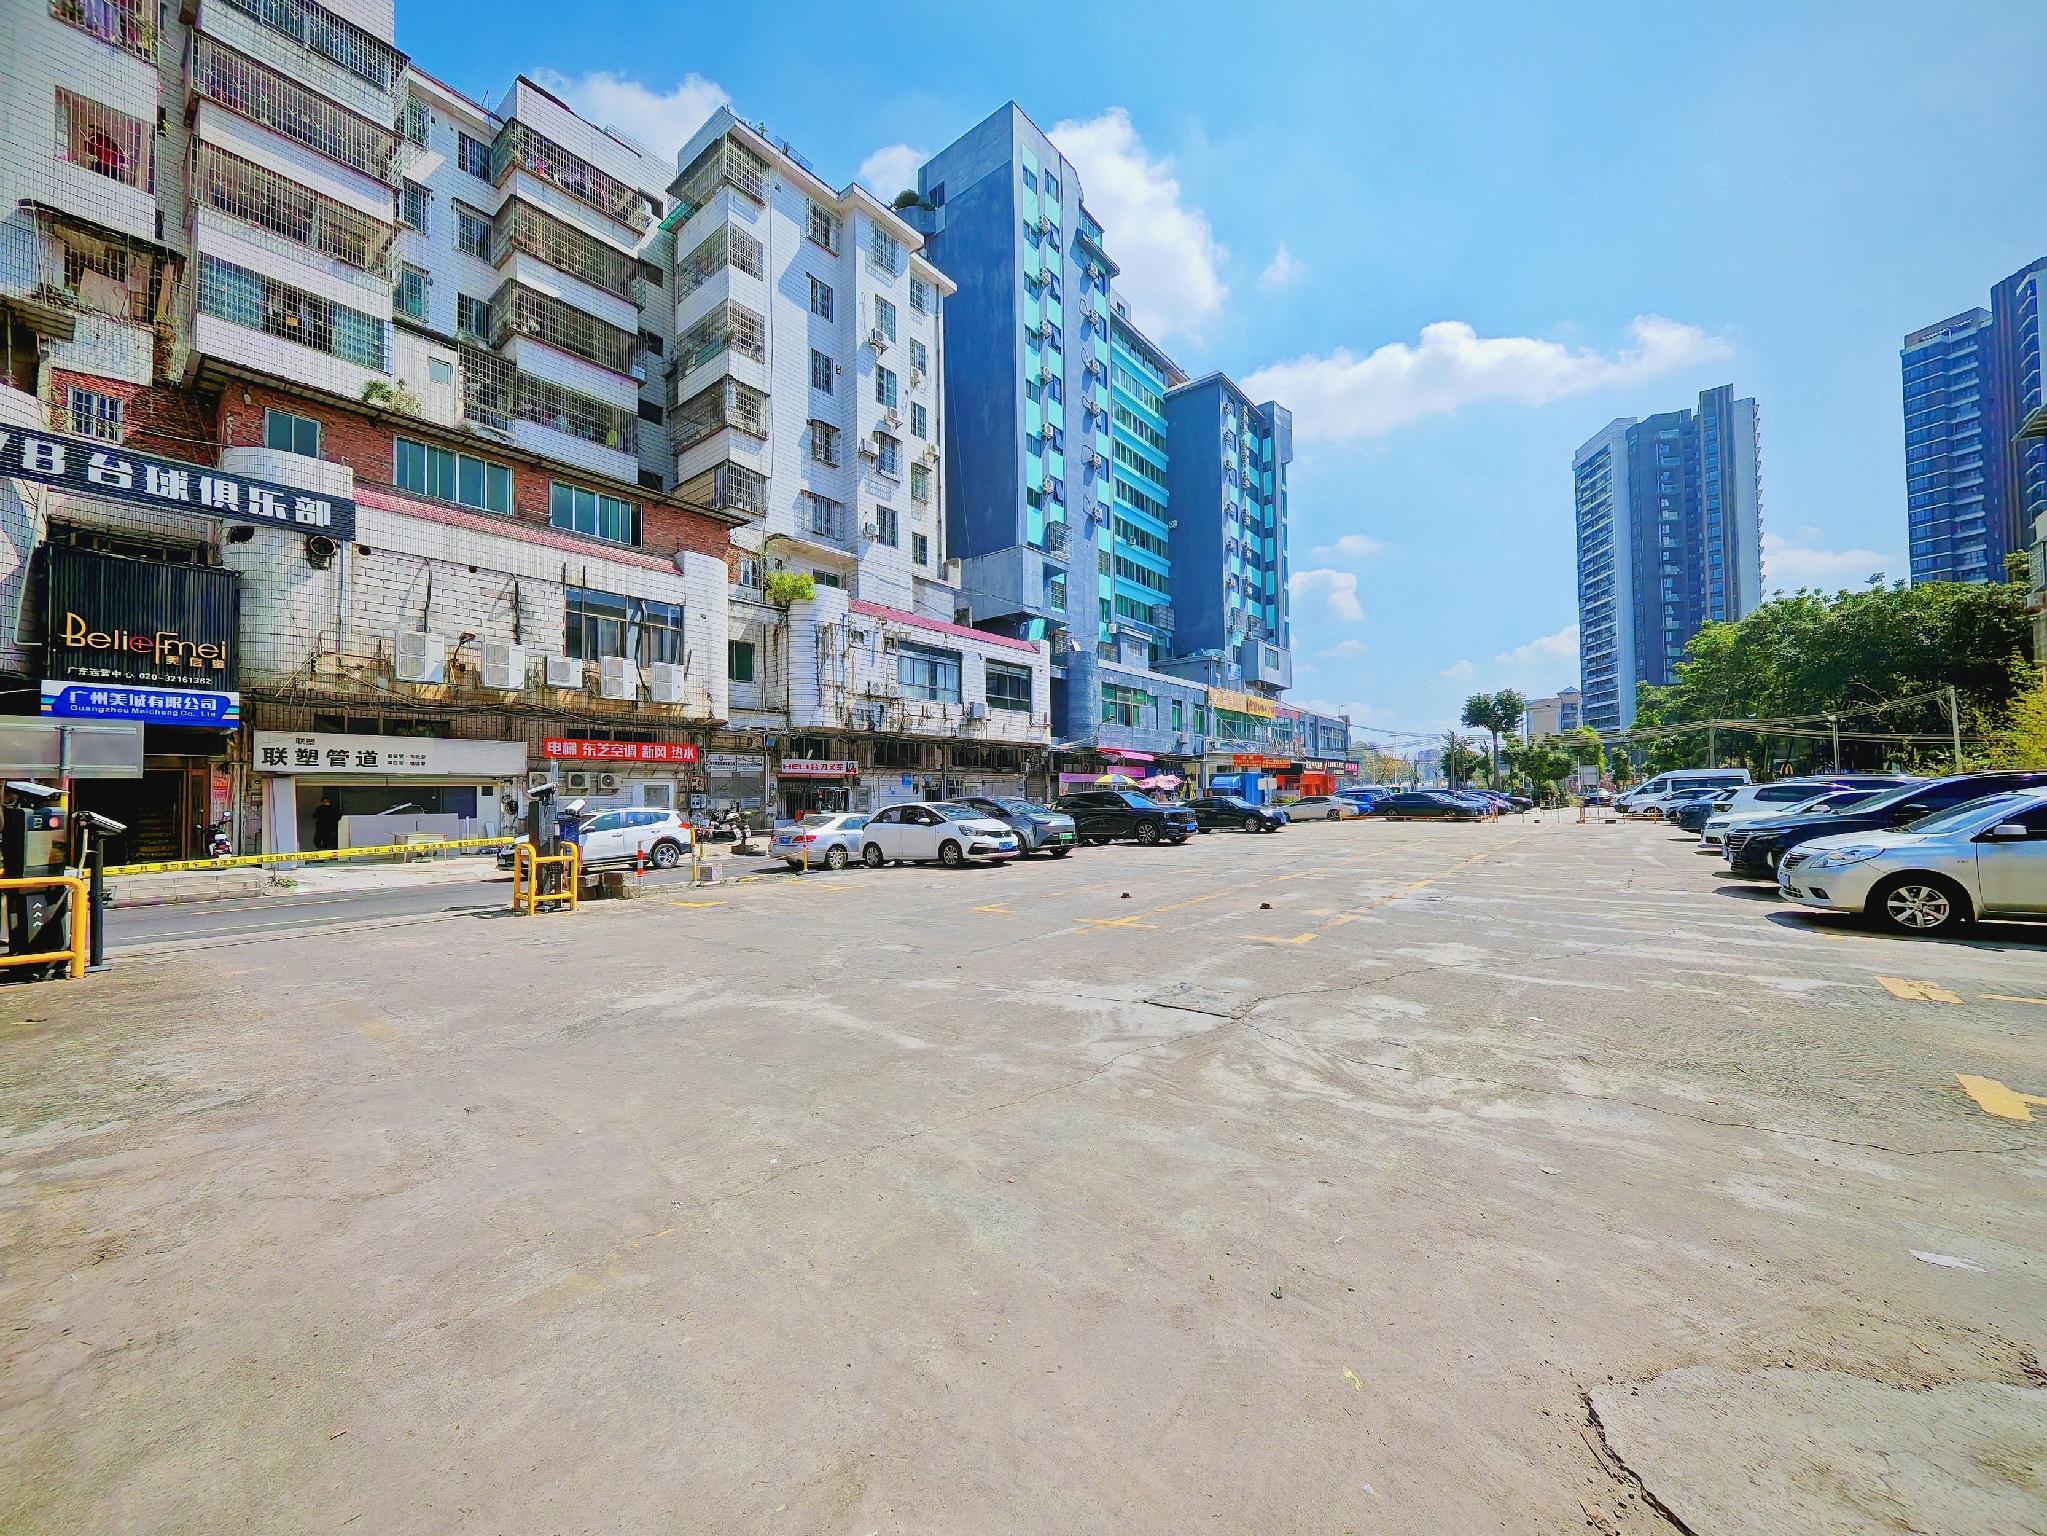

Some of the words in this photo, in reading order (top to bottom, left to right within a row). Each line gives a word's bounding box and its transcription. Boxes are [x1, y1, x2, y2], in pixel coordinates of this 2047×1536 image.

[70, 690, 217, 711] 广州美诚有限公司
[261, 747, 379, 768] 联塑管道
[547, 741, 577, 756] 电梯
[582, 743, 637, 758] 东芝空调
[641, 745, 667, 759] 新风
[671, 746, 695, 760] 热水
